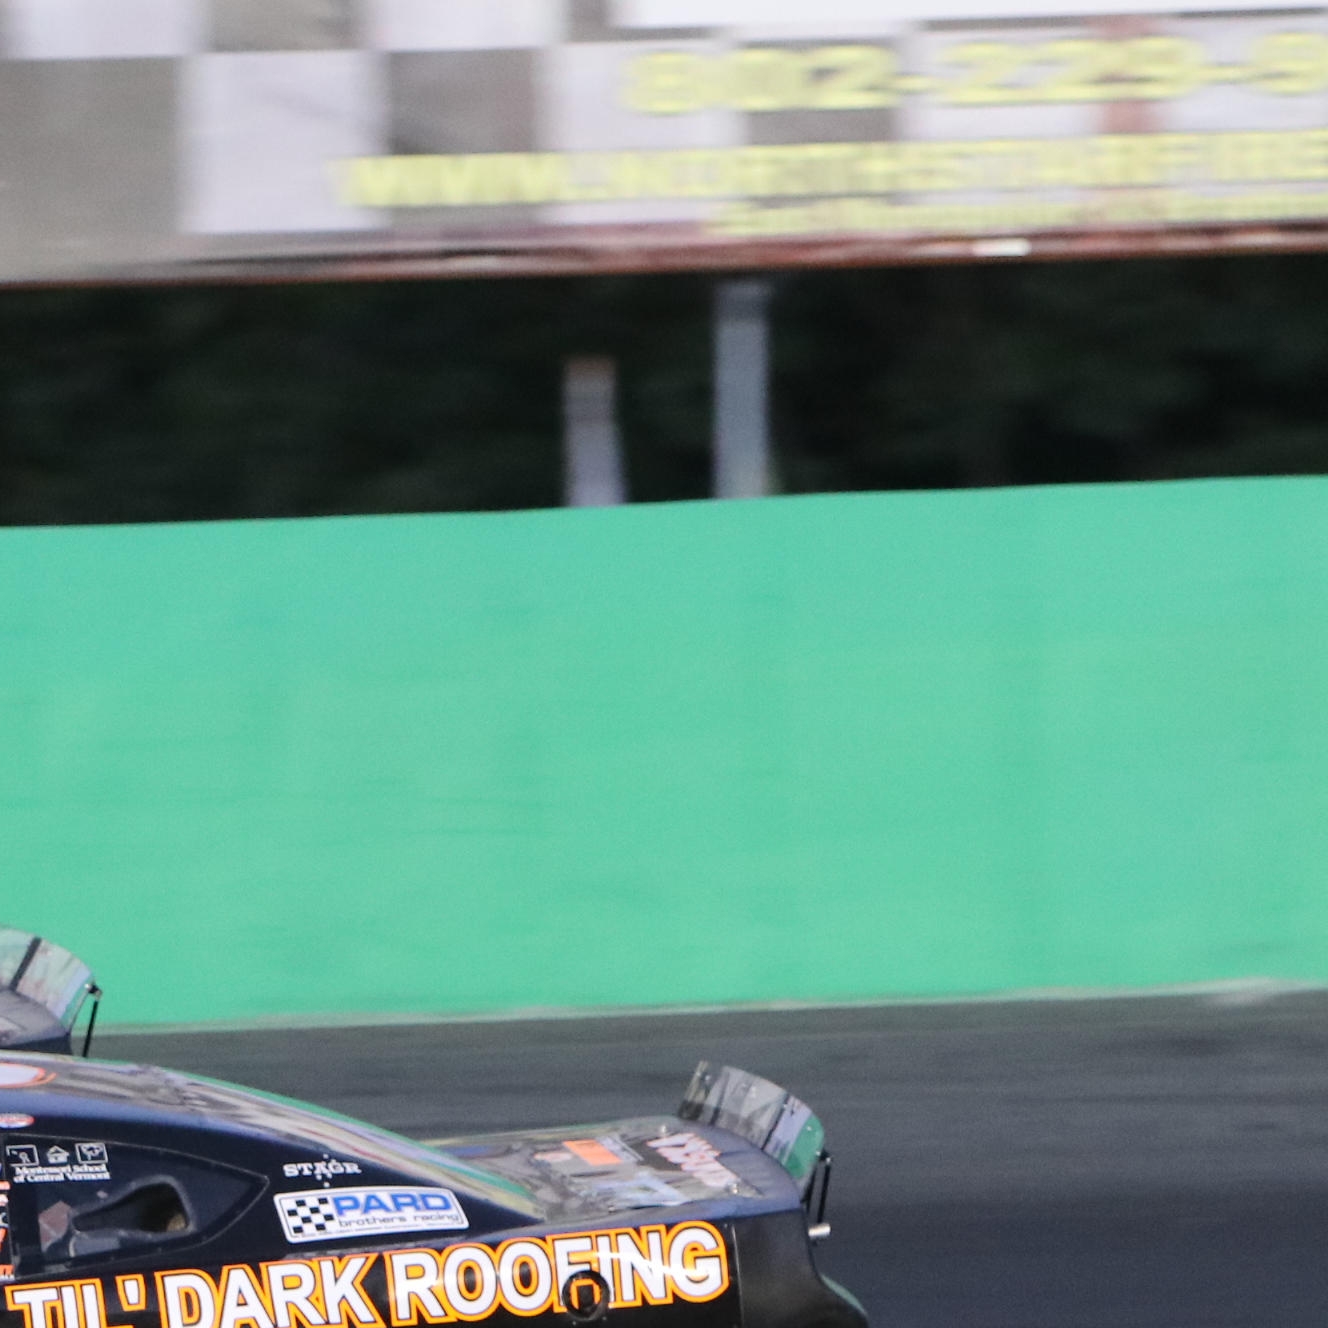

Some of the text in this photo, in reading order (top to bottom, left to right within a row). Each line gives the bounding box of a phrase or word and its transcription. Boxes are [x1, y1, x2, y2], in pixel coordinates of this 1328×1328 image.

[65, 1171, 111, 1181] Vermont
[72, 1163, 108, 1173] School
[332, 1193, 452, 1216] PARD
[338, 1210, 460, 1228] brothers racing
[387, 1224, 726, 1323] ROOFING
